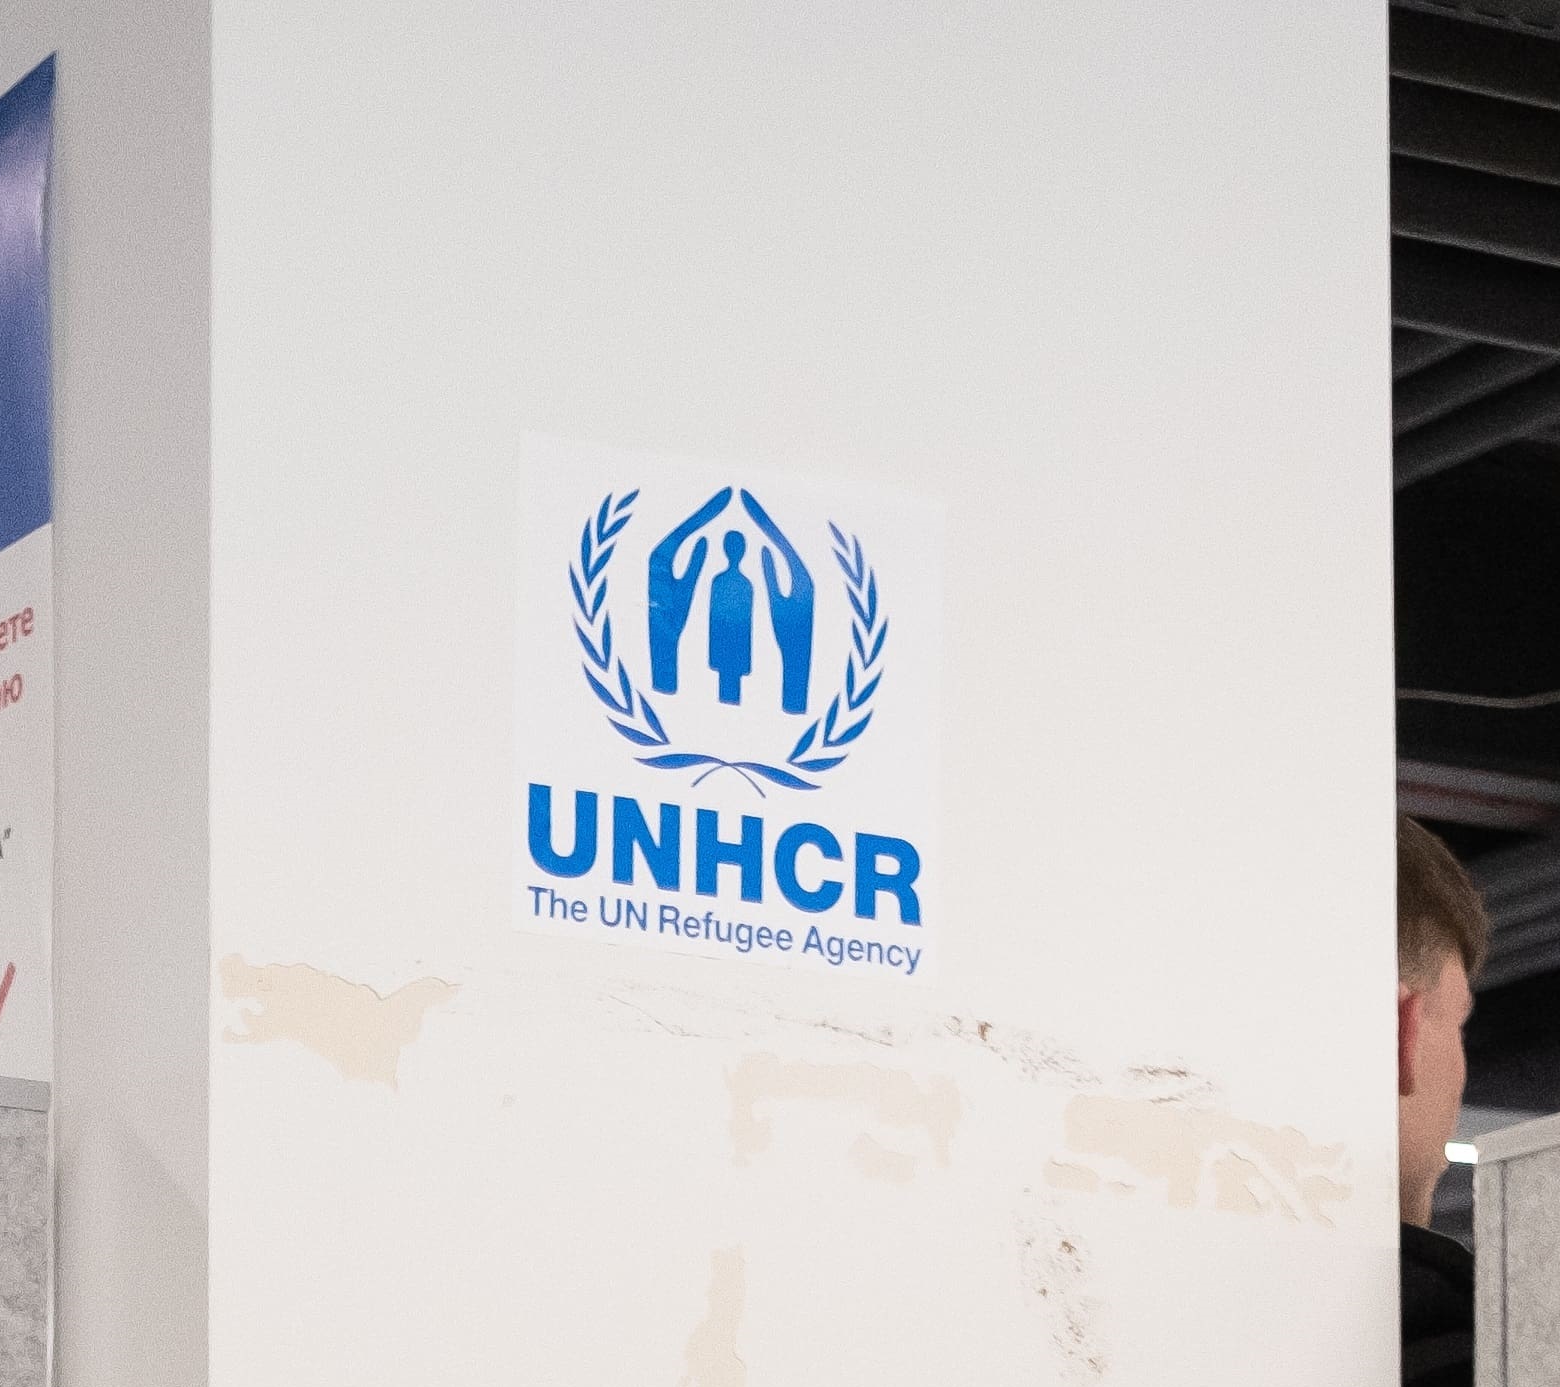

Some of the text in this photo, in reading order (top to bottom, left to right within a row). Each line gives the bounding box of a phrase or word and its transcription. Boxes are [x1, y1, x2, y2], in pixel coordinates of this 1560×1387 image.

[528, 783, 922, 926] UNHCR
[527, 885, 923, 976] The UN Refugee Agency
